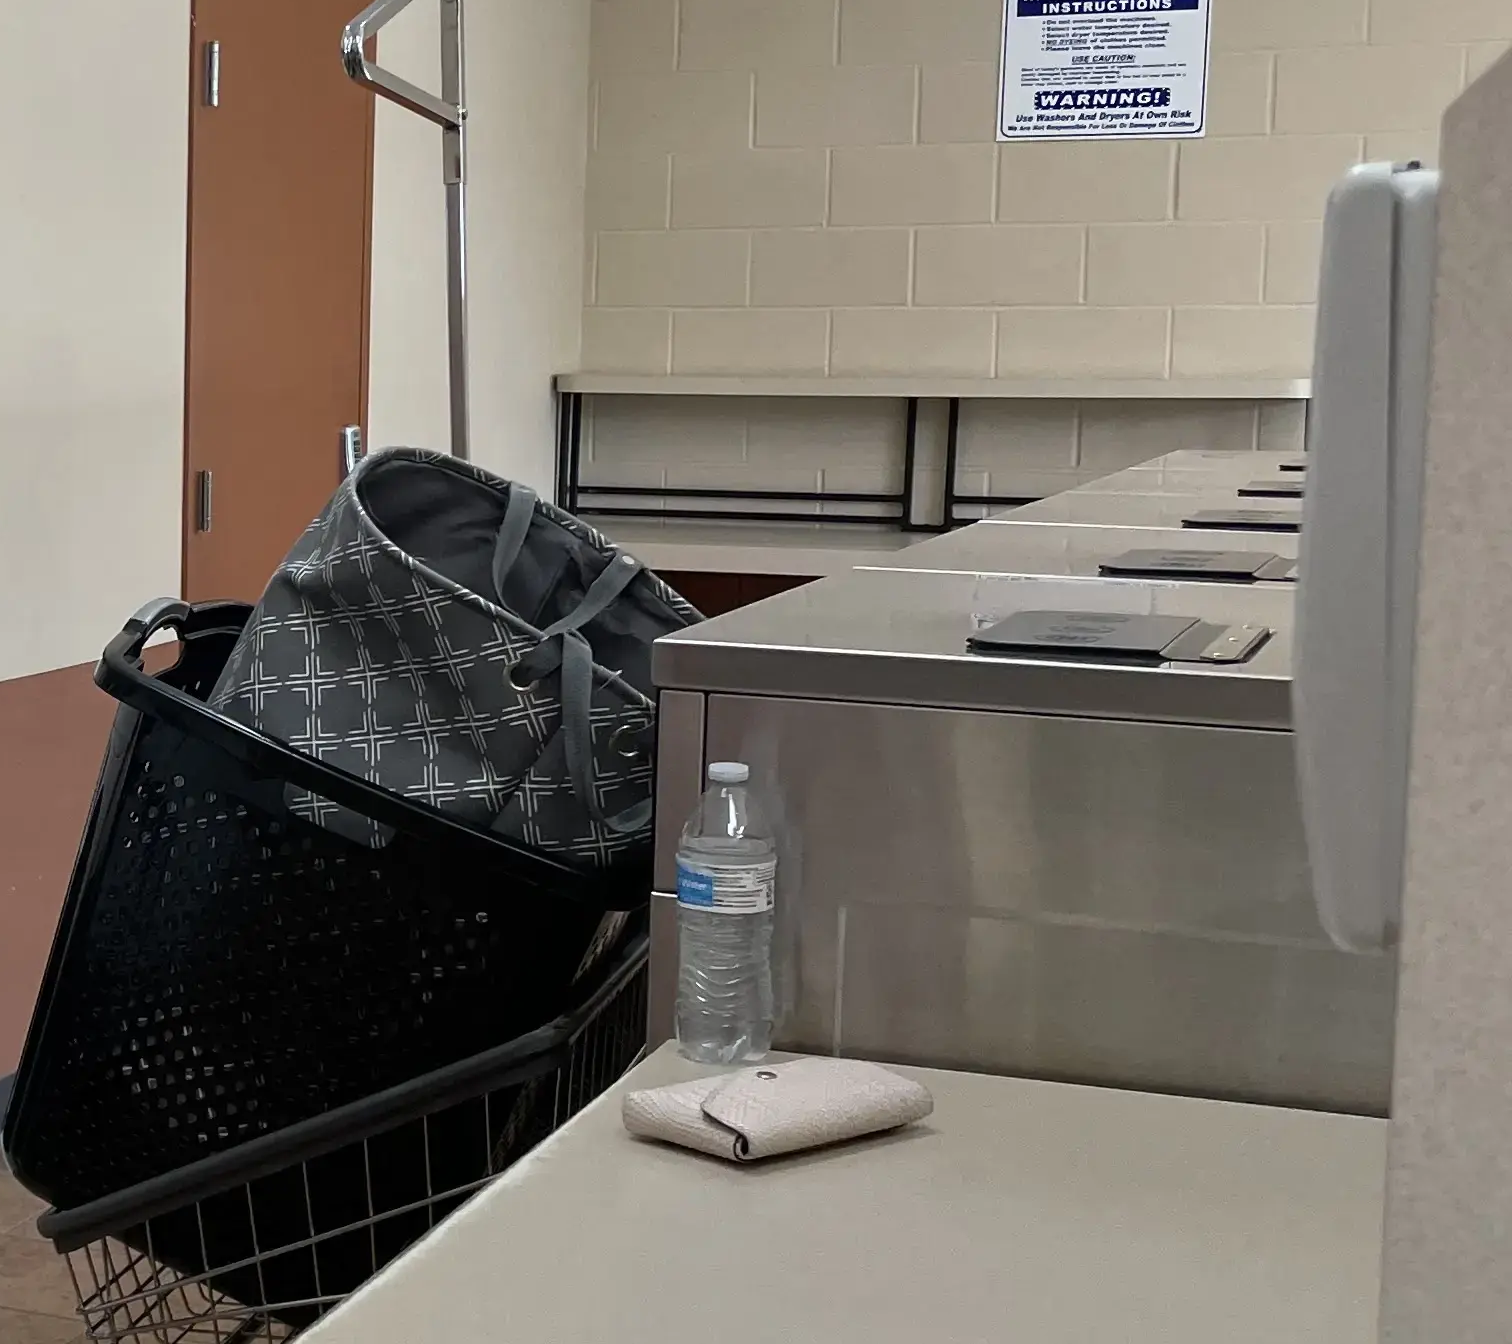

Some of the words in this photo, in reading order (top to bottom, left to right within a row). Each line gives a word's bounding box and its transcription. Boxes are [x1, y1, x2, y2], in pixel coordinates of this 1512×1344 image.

[1040, 91, 1161, 107] WARNING!
[1015, 114, 1033, 123] Use
[1036, 113, 1075, 122] Washers
[1078, 113, 1096, 121] And
[1099, 111, 1130, 122] Dryers
[1132, 111, 1144, 119] At
[1146, 110, 1167, 119] Own
[1170, 110, 1192, 119] Risk
